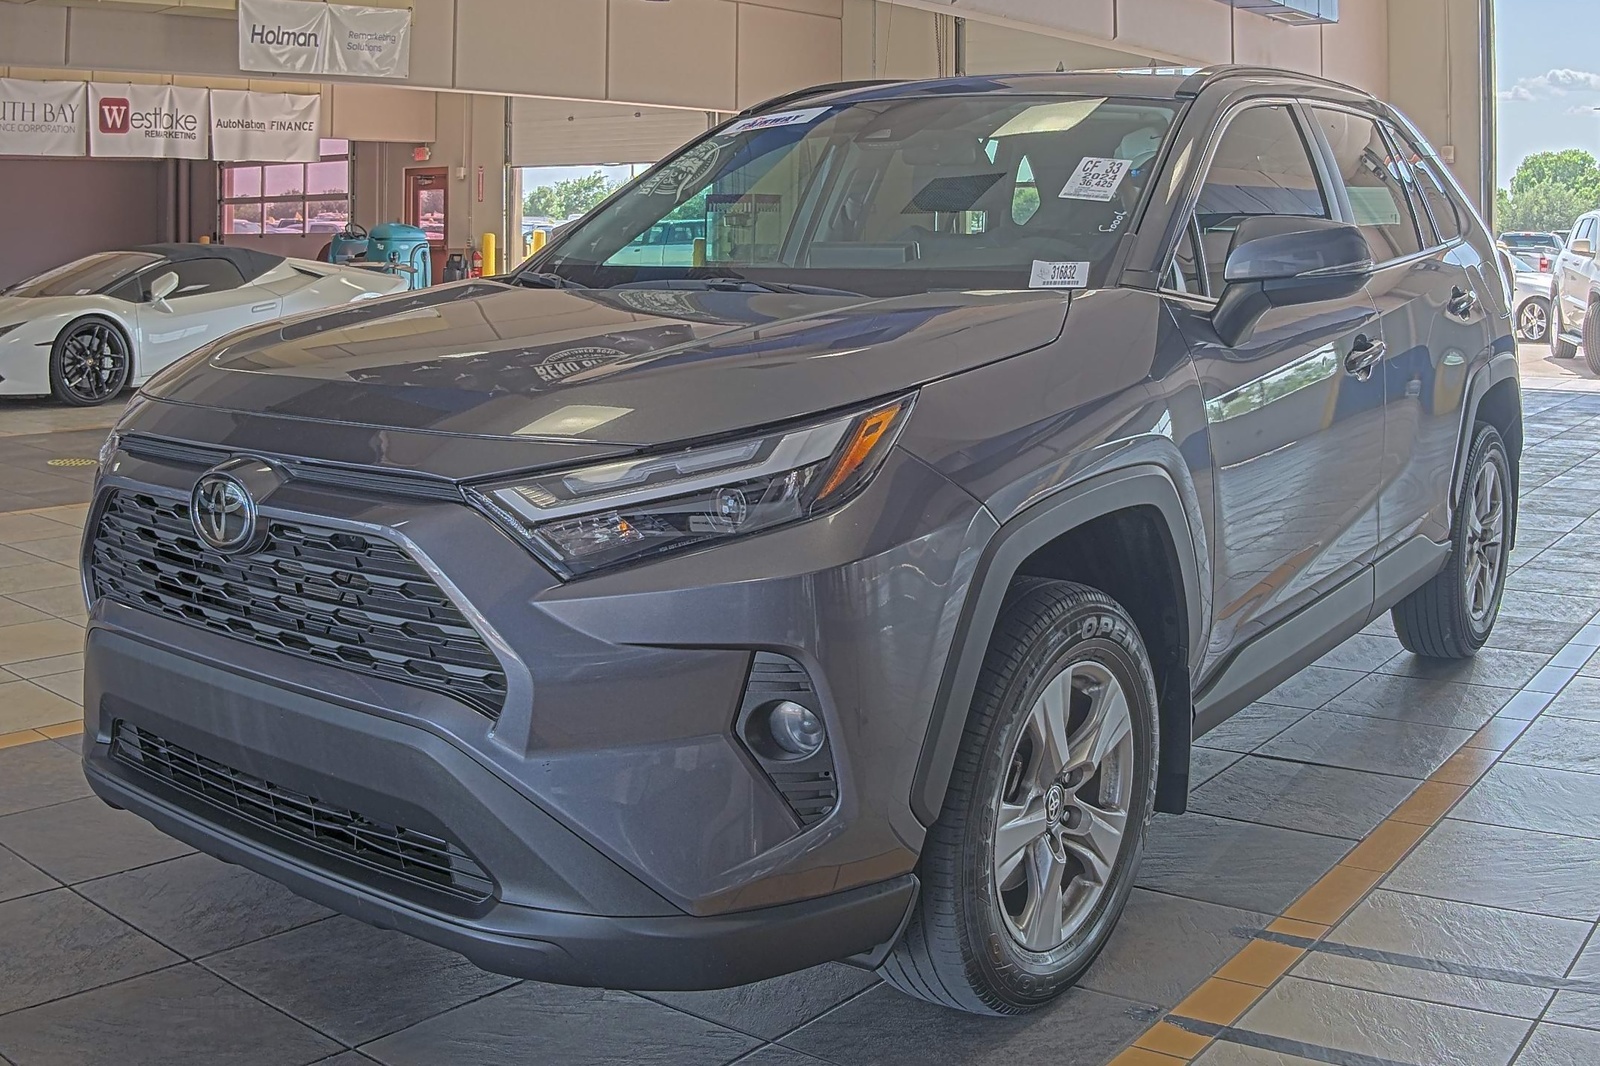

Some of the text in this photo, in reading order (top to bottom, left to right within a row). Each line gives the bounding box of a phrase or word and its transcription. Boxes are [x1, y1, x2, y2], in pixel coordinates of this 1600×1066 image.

[250, 24, 319, 47] Holman
[348, 30, 397, 44] Remarketing
[346, 42, 383, 52] Solutions
[43, 102, 79, 123] BAY
[102, 105, 198, 131] Westlake
[17, 124, 76, 134] CORPORATION
[215, 118, 315, 131] AutoNation FINANCE
[144, 129, 197, 140] REMARKETING
[1082, 160, 1123, 175] CF 33
[1079, 179, 1114, 188] 36,425
[1082, 172, 1118, 181] 2024
[1050, 265, 1077, 280] 316832
[1081, 615, 1137, 656] OPEN
